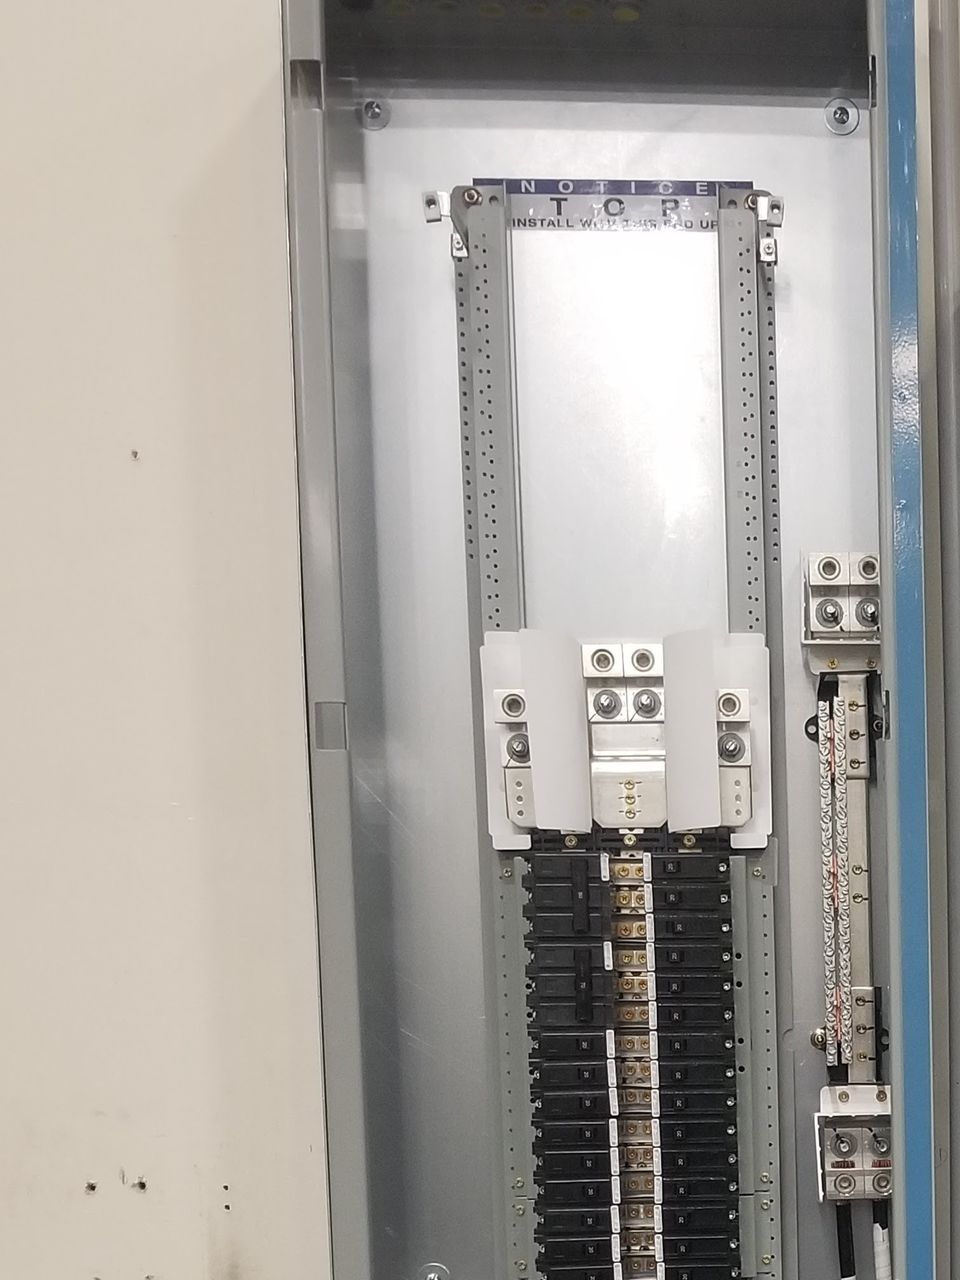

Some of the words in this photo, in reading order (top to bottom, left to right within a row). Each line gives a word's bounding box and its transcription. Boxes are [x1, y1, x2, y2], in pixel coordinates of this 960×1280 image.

[520, 180, 708, 195] NOTICE
[550, 197, 680, 217] TOP
[512, 218, 574, 228] INSTALL
